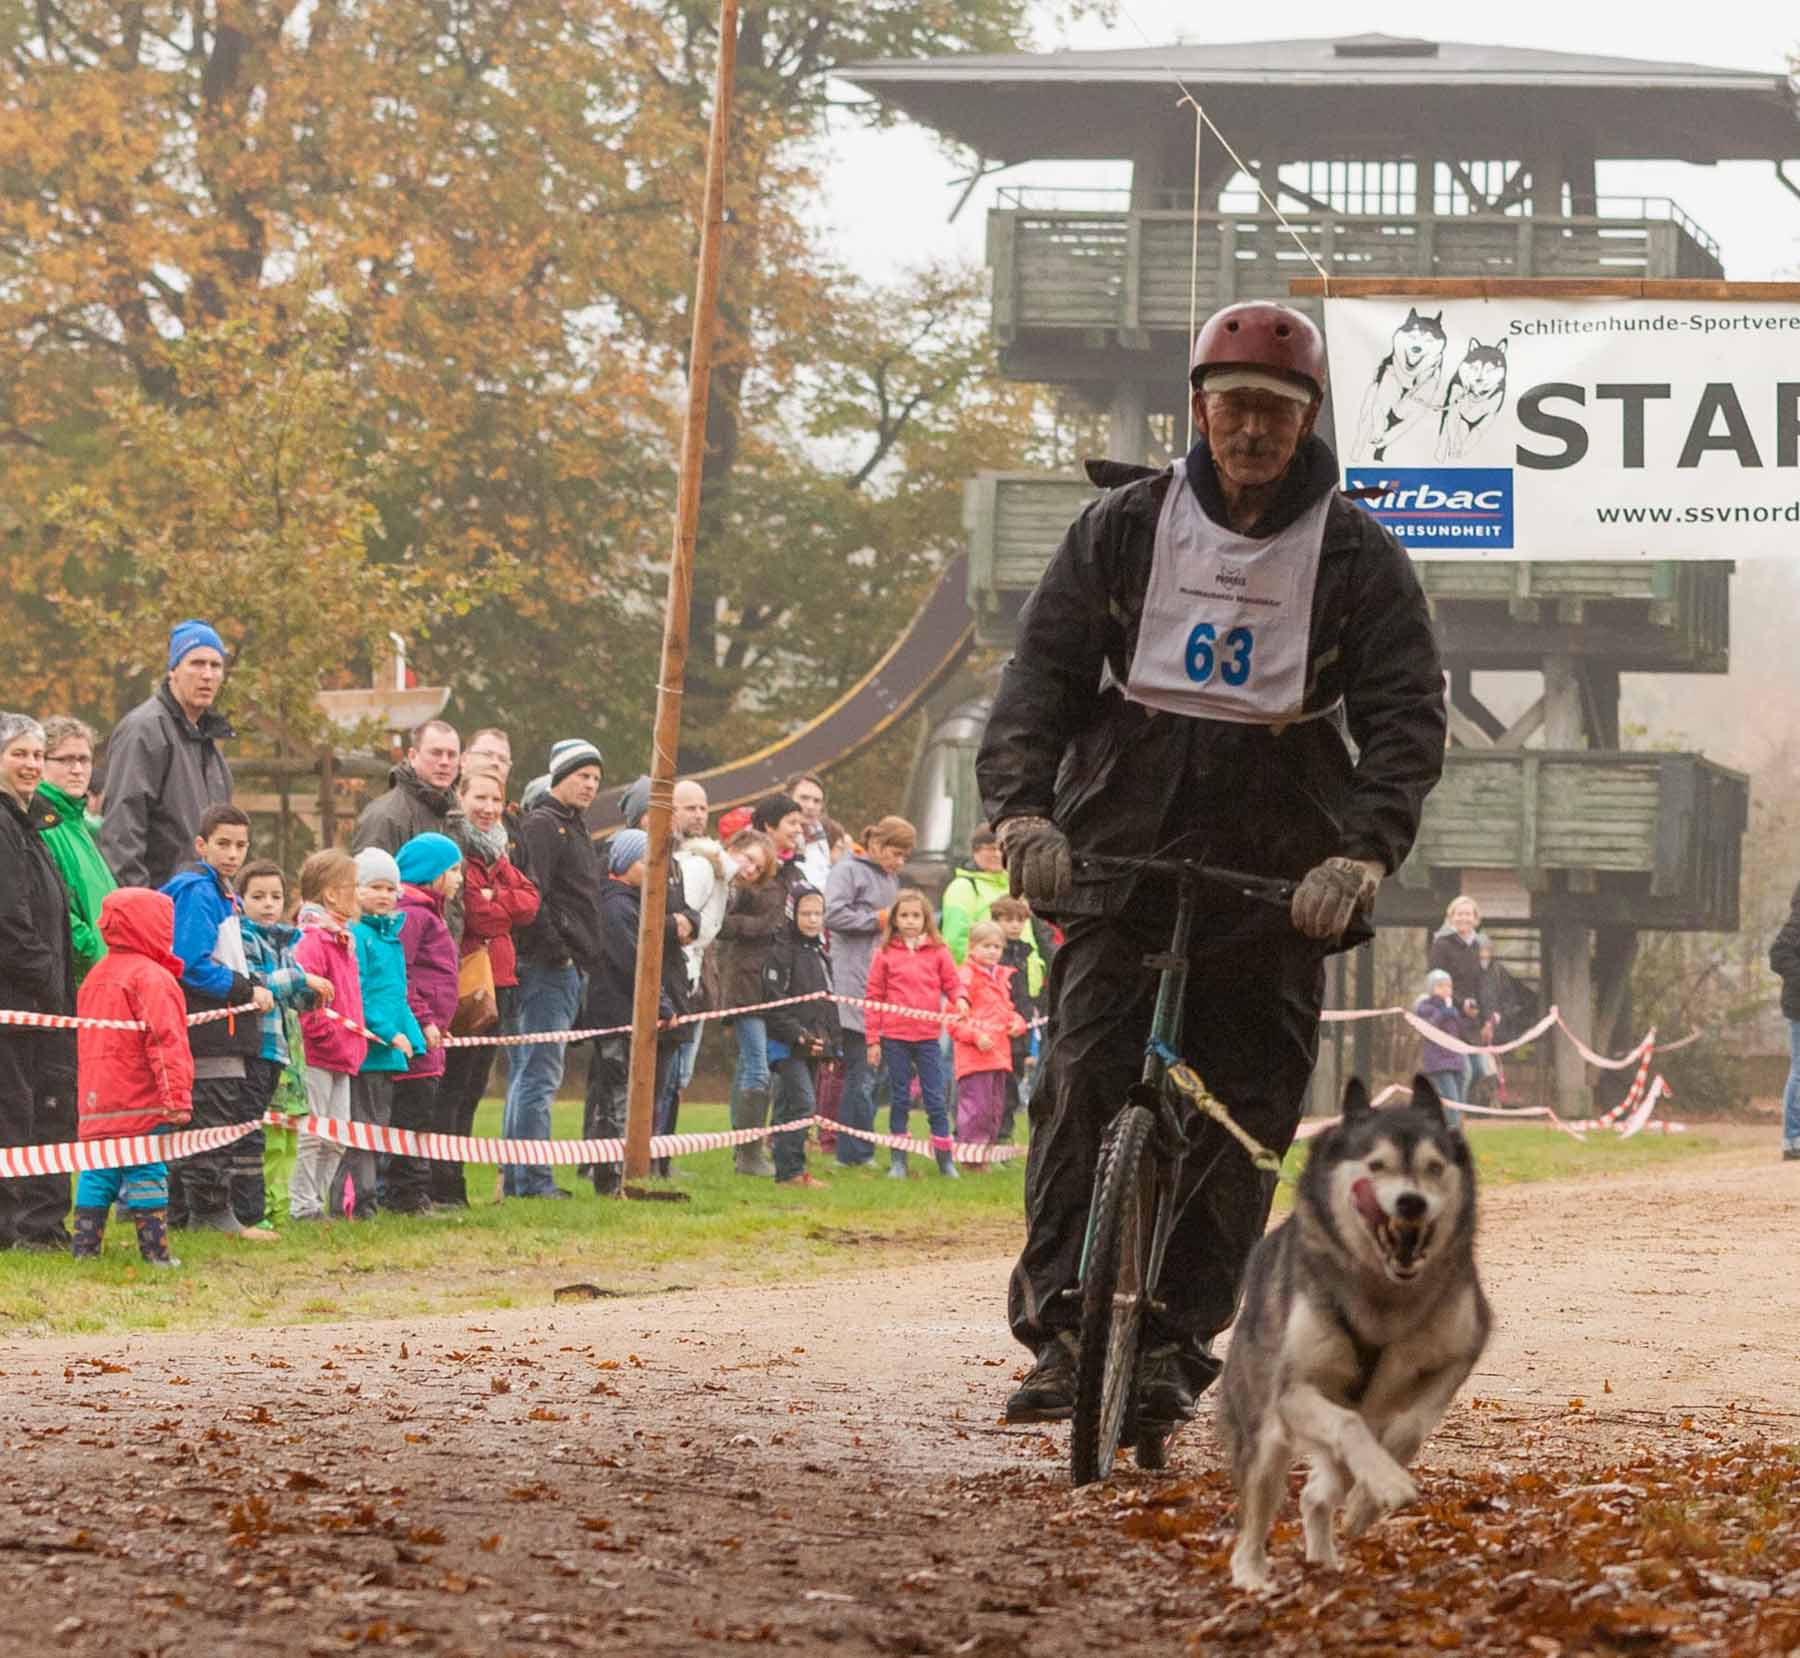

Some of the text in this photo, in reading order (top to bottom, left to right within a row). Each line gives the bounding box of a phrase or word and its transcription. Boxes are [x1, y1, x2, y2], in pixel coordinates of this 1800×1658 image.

[1352, 480, 1503, 509] Virbac
[1384, 524, 1503, 537] GESUNDHEIT
[1184, 622, 1254, 687] 63
